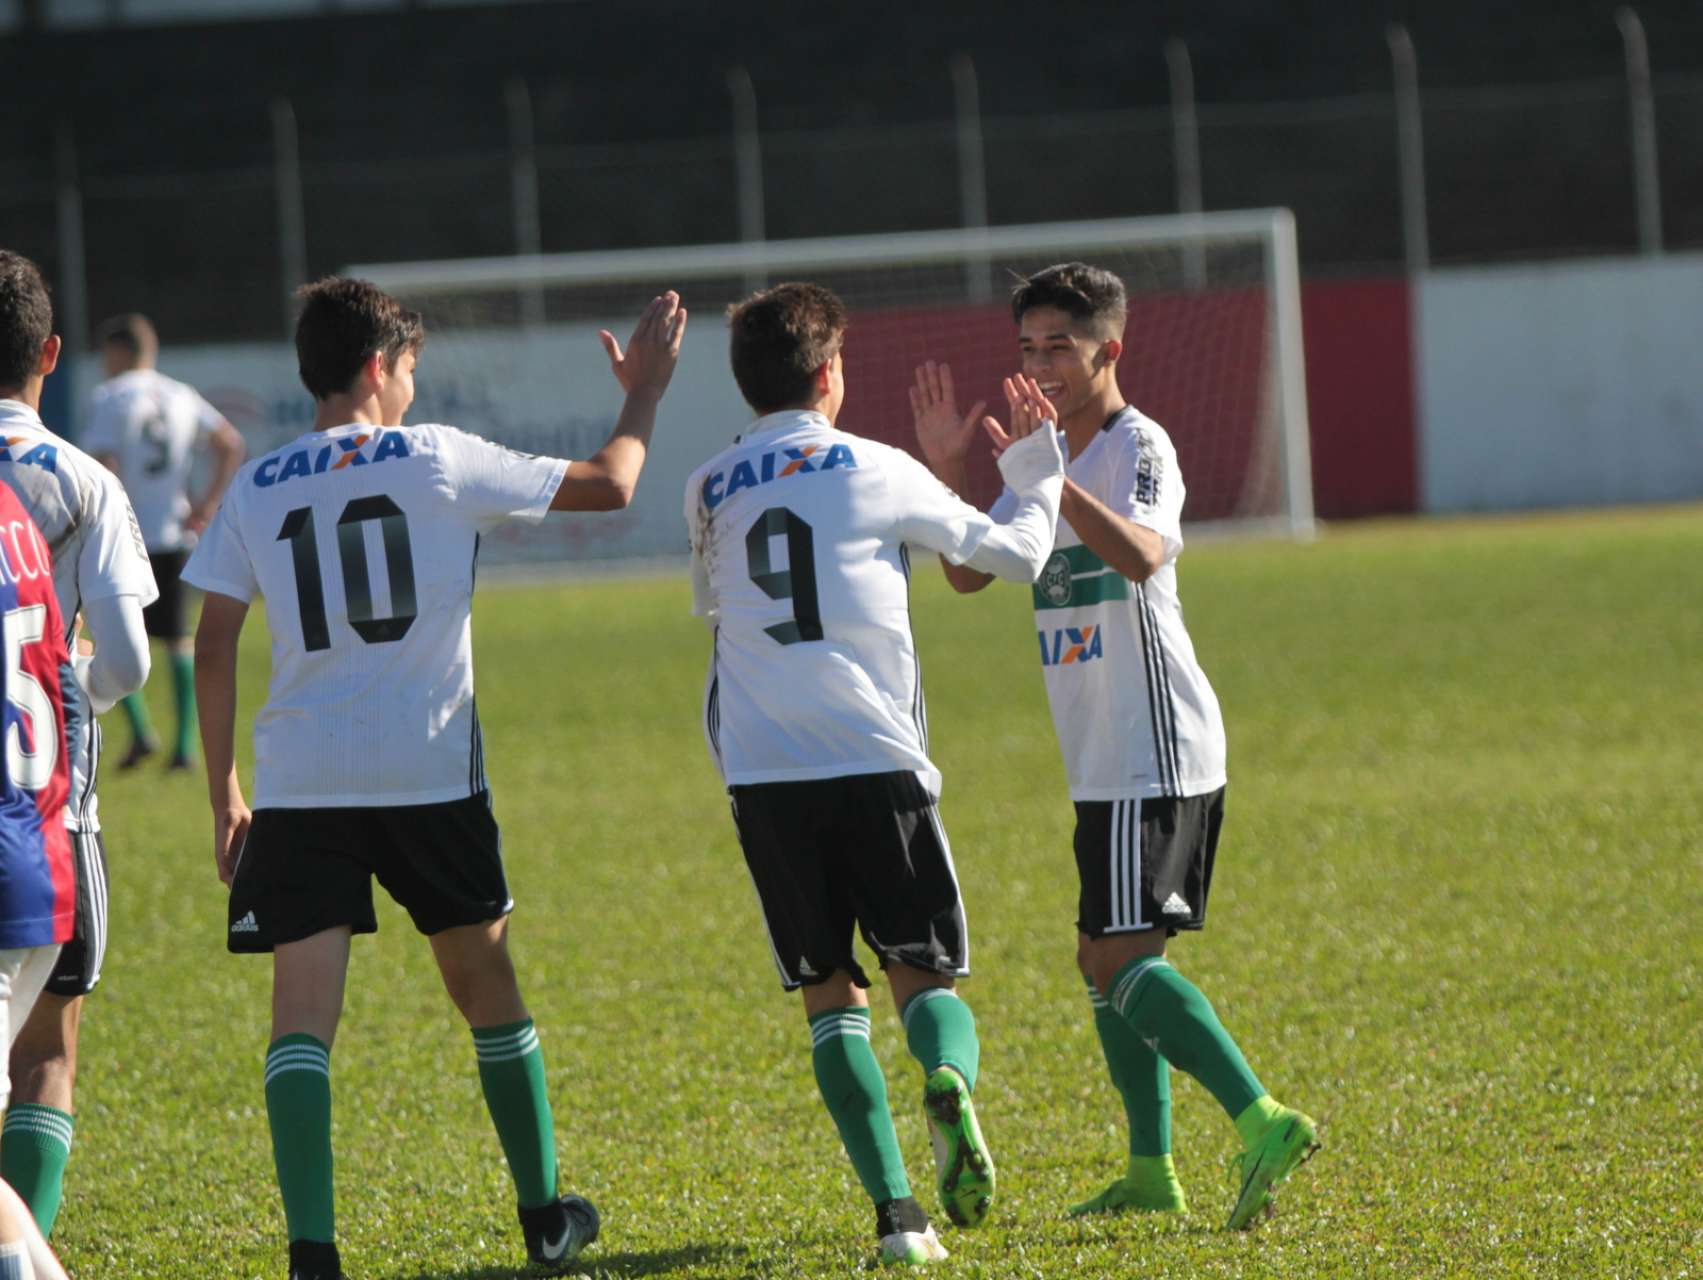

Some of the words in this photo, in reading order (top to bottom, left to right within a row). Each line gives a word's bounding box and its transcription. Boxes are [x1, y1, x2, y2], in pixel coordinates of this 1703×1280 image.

[252, 431, 411, 488] CAIXA
[703, 443, 858, 509] CAIXA
[276, 494, 418, 652] 10
[745, 506, 825, 646] 9
[3, 603, 59, 790] 5
